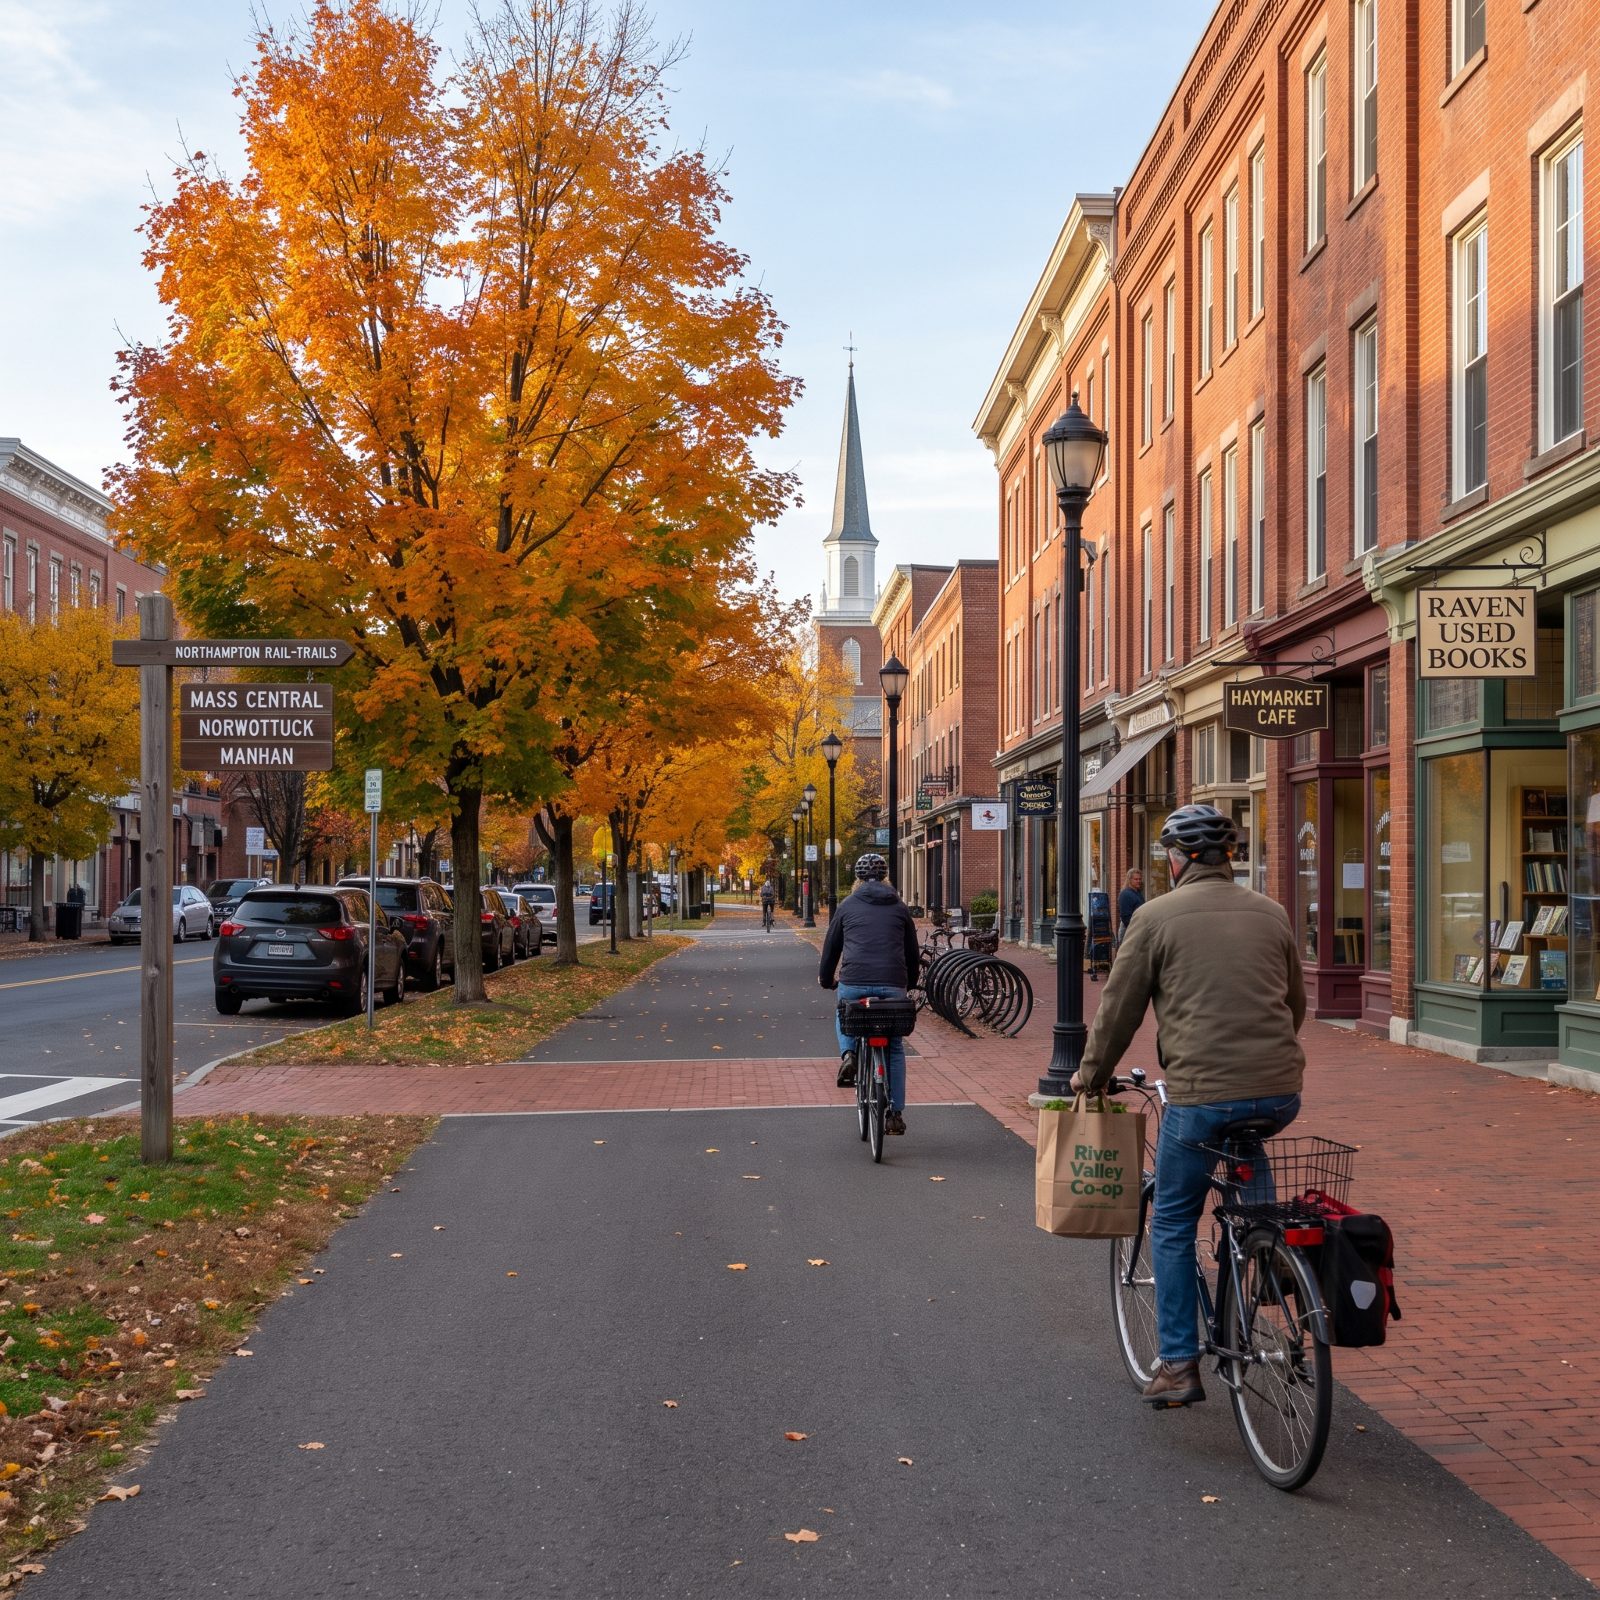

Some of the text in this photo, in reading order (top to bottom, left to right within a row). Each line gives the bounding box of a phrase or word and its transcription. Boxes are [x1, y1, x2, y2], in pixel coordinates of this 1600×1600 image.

[1427, 595, 1527, 617] RAVEN
[1438, 621, 1516, 644] USED
[175, 646, 338, 659] NORTHAMPTON RAIL-TRAILS
[1427, 647, 1528, 670] BOOKS
[190, 690, 324, 709] MASS CENTRAL
[1231, 689, 1323, 706] HAYMARKET
[1257, 709, 1297, 725] CAFE
[199, 718, 314, 737] NORWOTTUCK
[220, 747, 294, 765] MANHAN
[1074, 1145, 1119, 1161] River
[1070, 1161, 1123, 1181] Valley
[1070, 1179, 1123, 1199] Co-op
